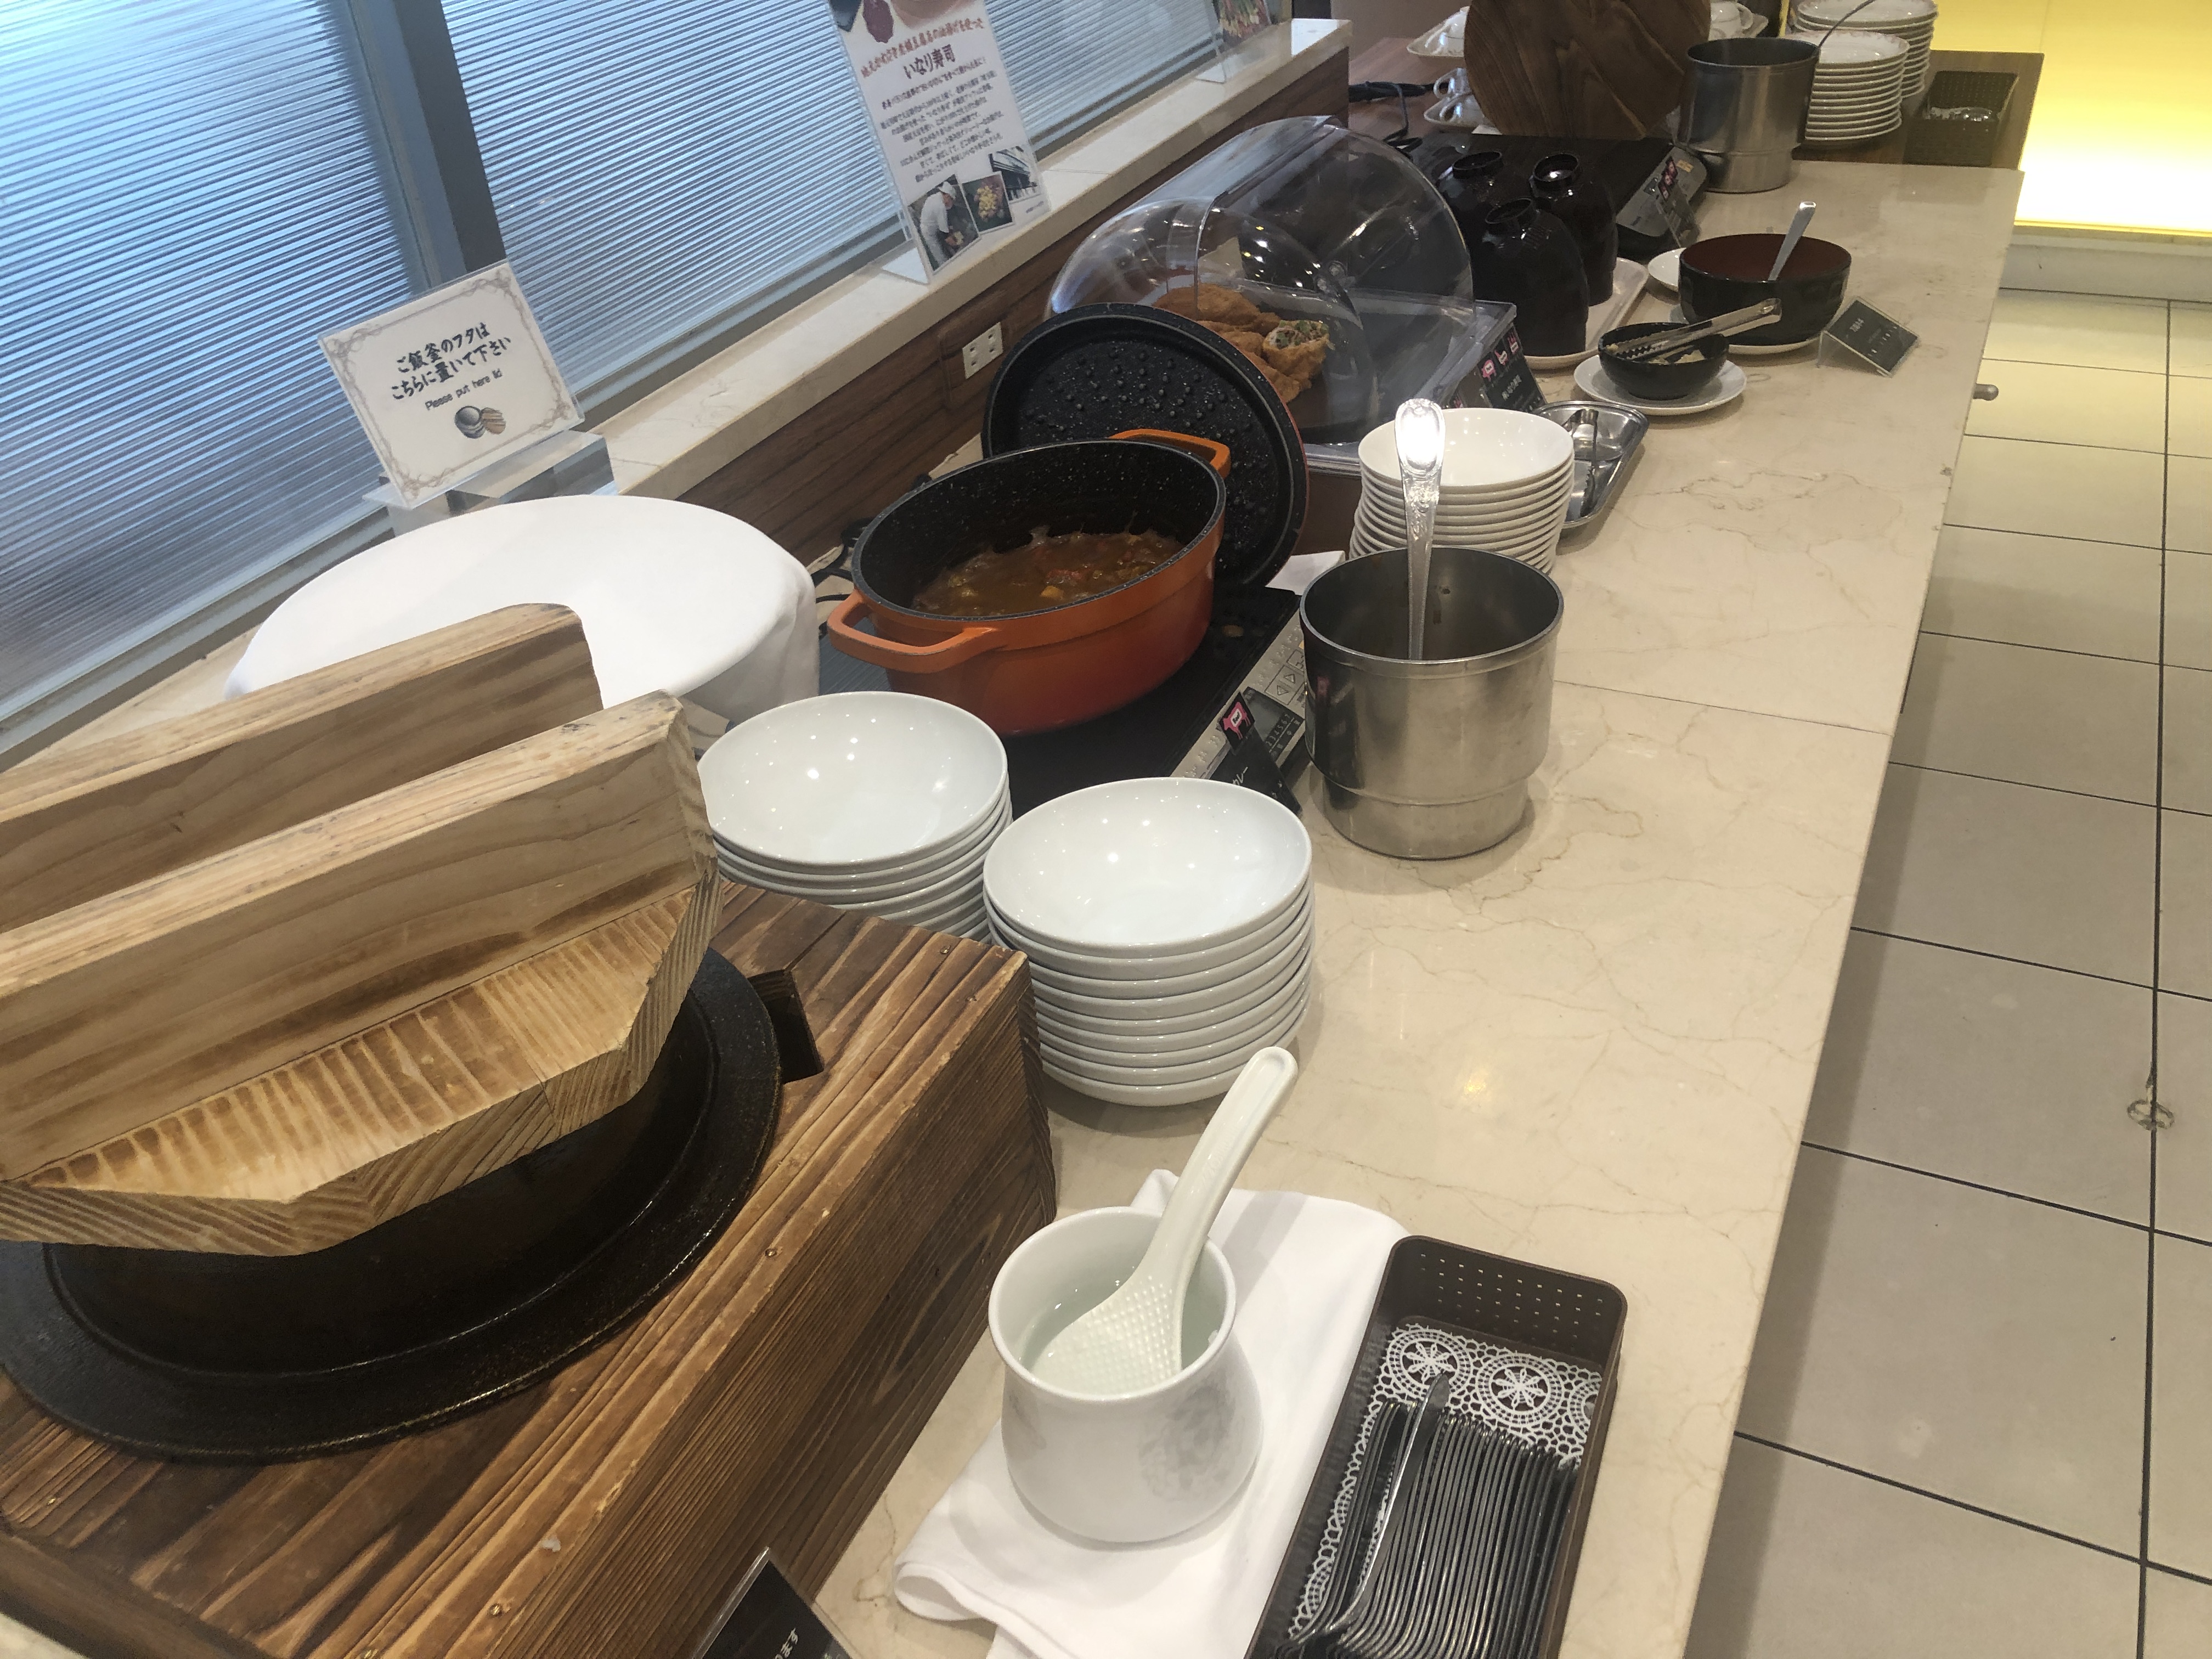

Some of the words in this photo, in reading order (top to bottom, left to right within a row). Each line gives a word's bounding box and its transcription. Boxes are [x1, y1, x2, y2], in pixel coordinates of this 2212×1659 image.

[903, 43, 956, 80] いなり寿司
[391, 337, 511, 400] こちらに置いて下さい
[397, 322, 490, 373] ご飯釜のフタは
[425, 393, 453, 410] Please
[455, 385, 471, 398] put
[472, 375, 491, 388] here
